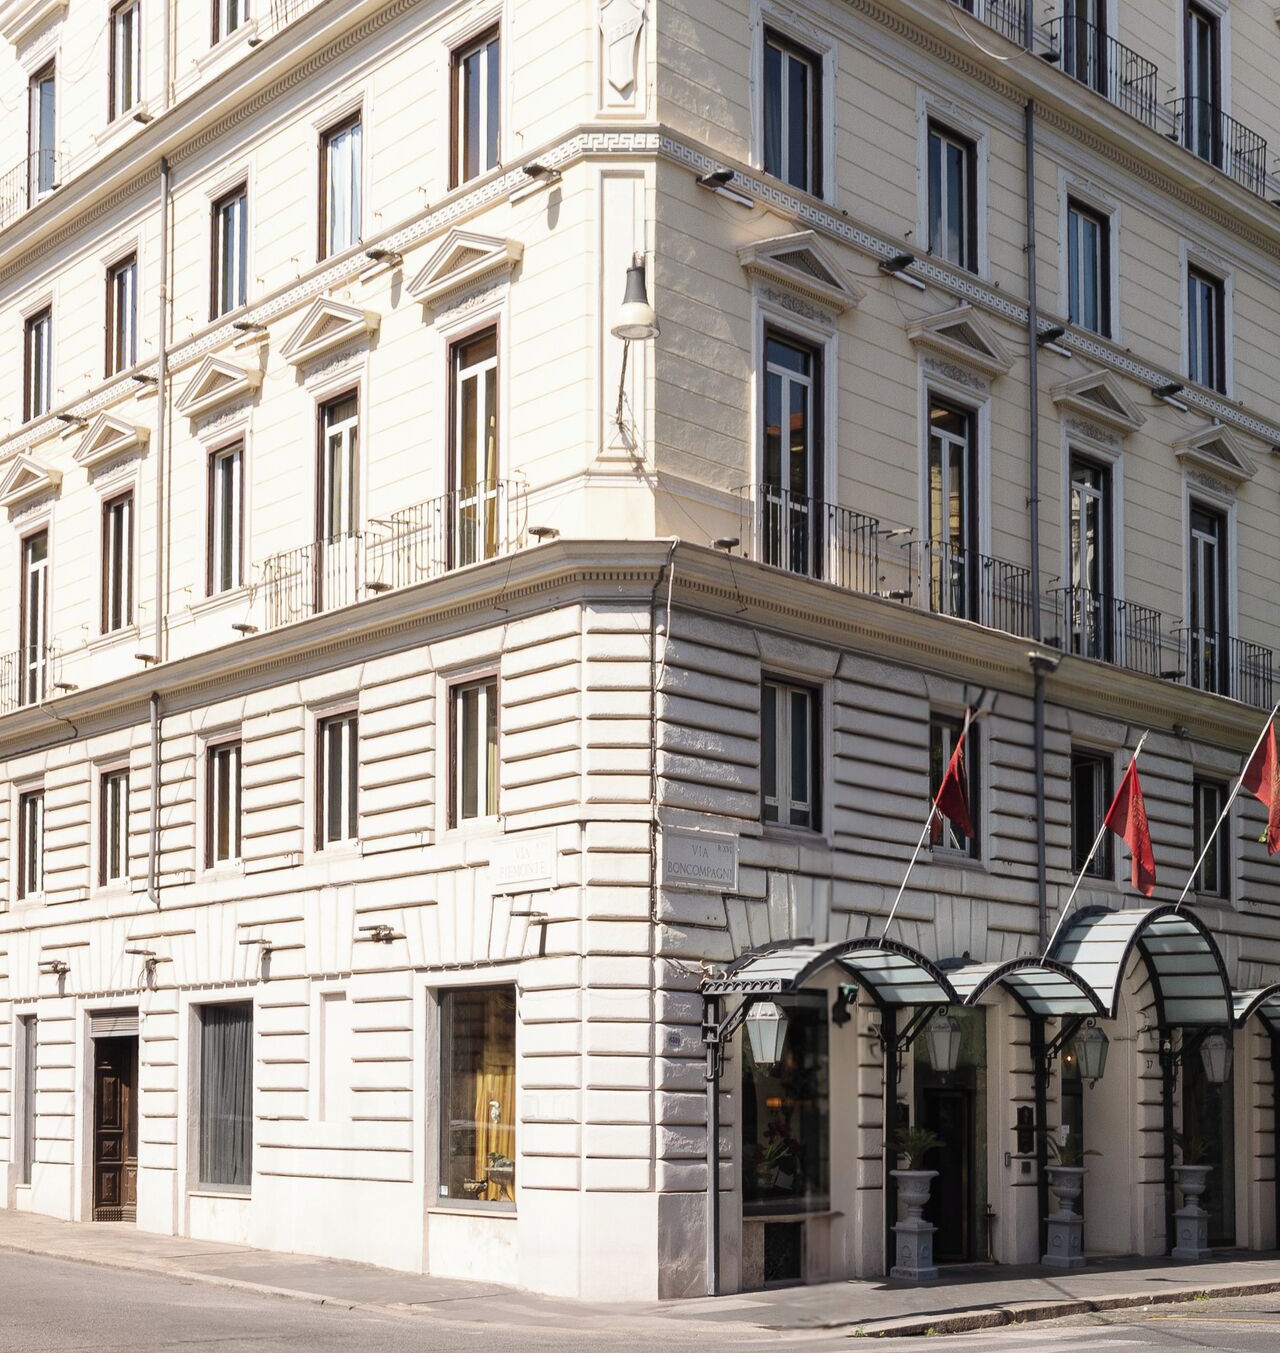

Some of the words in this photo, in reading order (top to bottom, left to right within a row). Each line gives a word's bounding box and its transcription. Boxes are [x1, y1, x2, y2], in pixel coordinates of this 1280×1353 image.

[515, 847, 530, 859] VIA
[692, 844, 709, 858] VIA
[667, 861, 732, 881] BONCOMPAGNI
